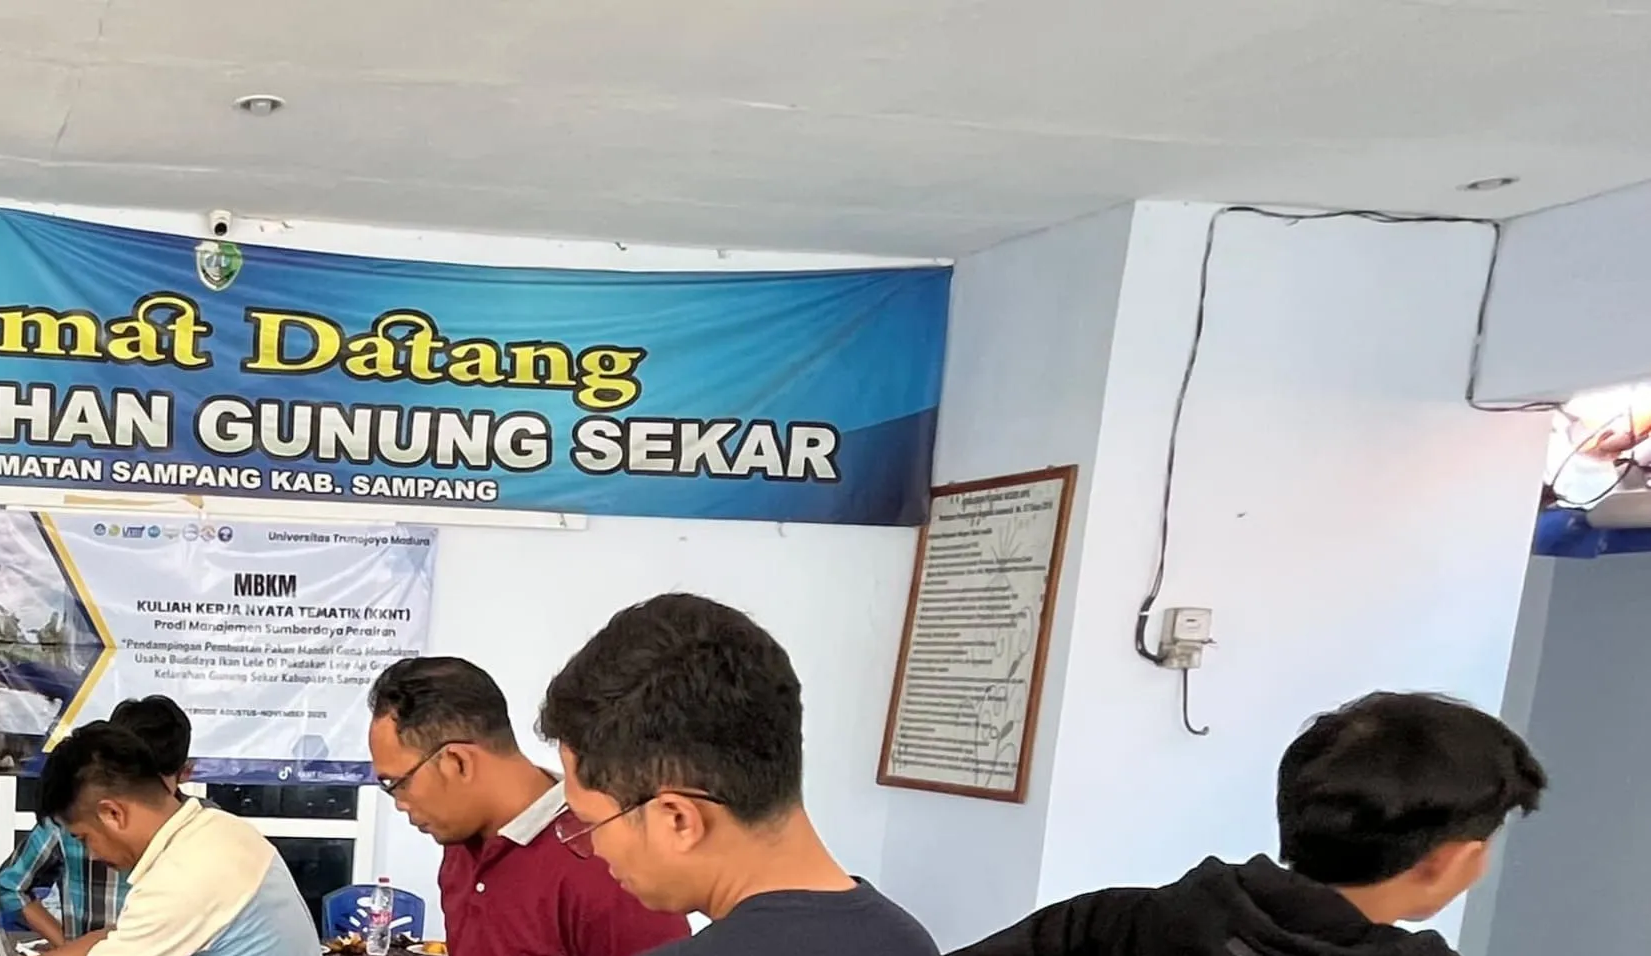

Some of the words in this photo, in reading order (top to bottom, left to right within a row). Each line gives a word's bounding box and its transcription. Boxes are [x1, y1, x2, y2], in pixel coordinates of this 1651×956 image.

[242, 306, 646, 411] Datang
[197, 397, 549, 471] GUNUNG
[572, 417, 839, 481] SEKAR
[111, 461, 262, 491] SAMPANG
[271, 469, 344, 496] KAB.
[351, 474, 498, 503] SAMPANG
[268, 531, 330, 543] Universitas
[333, 533, 388, 547] Trunojoyo
[390, 535, 430, 546] Madura
[234, 573, 297, 598] MBKM
[137, 600, 191, 613] KULIAH
[196, 603, 241, 615] KERJA
[245, 604, 294, 617] NYATA
[299, 607, 360, 619] TEMATIK
[364, 608, 411, 622] (KKNT)
[154, 619, 187, 631] Prodi
[189, 621, 262, 635] Manajemen
[265, 624, 343, 639] Sumberdaya
[346, 626, 396, 637] Perairan
[135, 653, 167, 665] Usaha
[169, 655, 216, 668] Budidaya
[219, 656, 241, 667] Ikan
